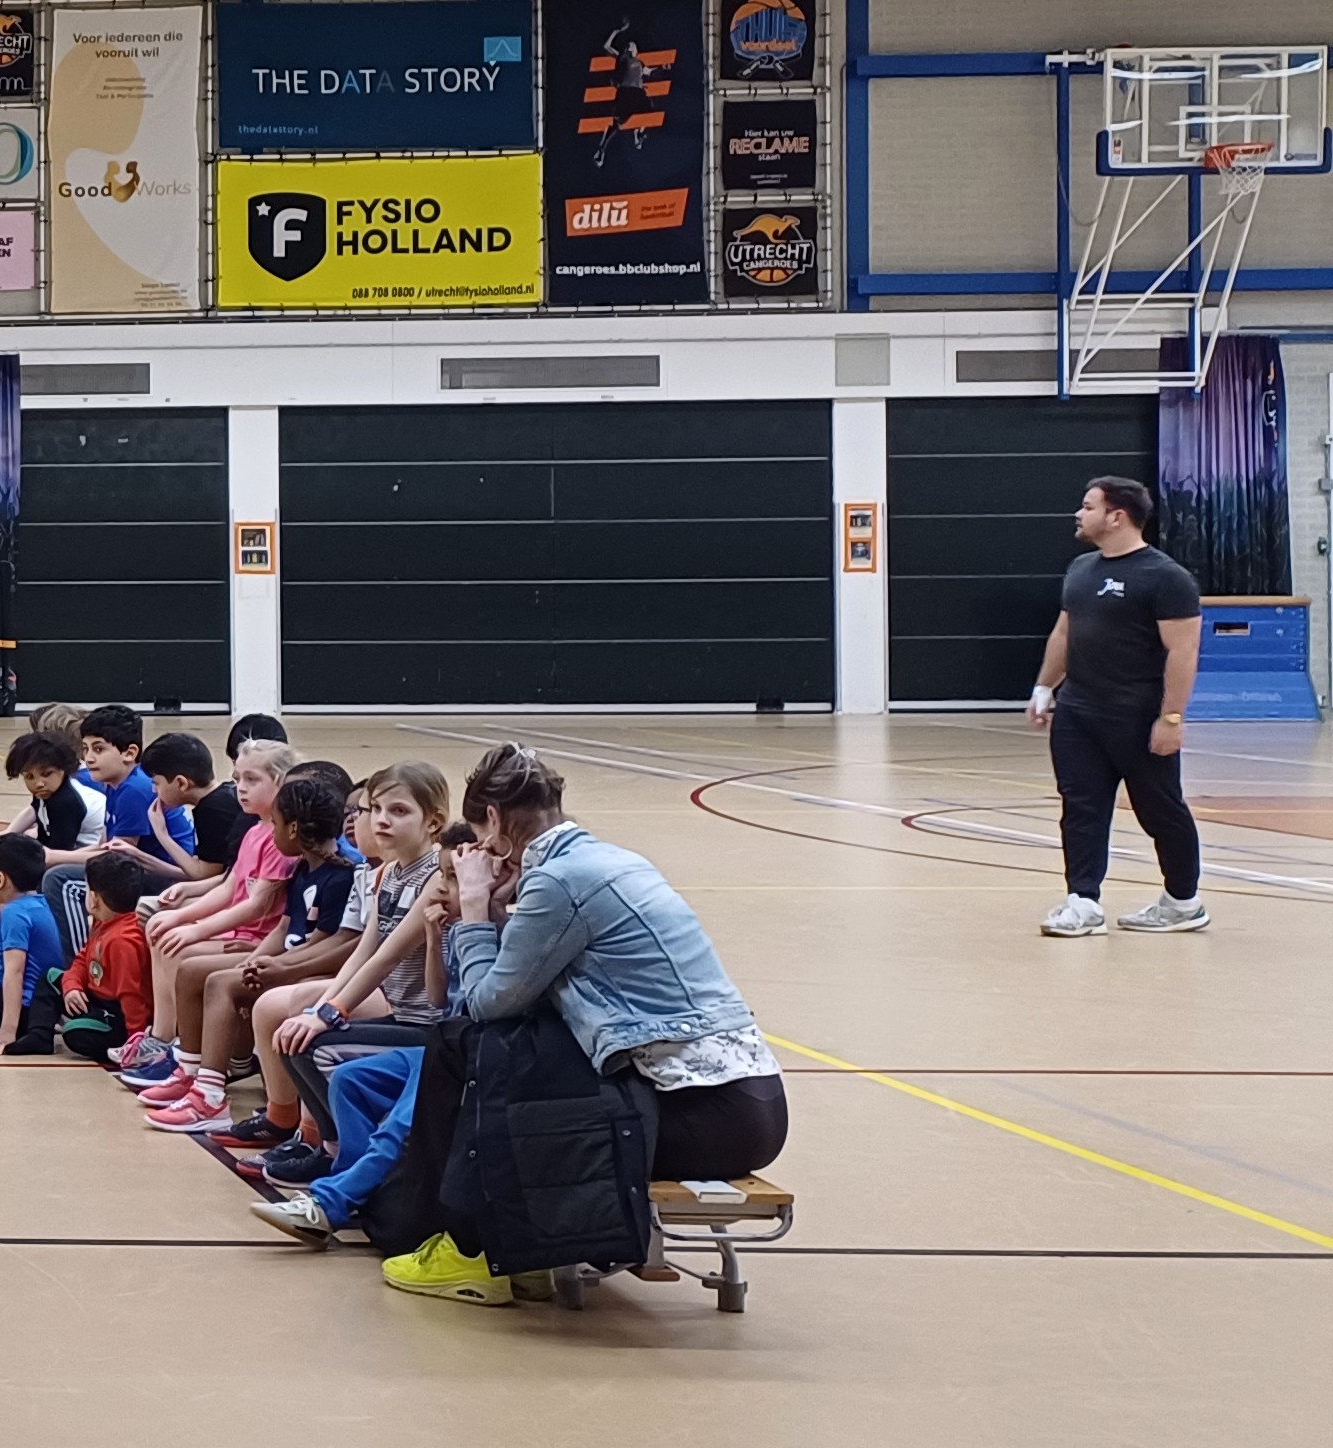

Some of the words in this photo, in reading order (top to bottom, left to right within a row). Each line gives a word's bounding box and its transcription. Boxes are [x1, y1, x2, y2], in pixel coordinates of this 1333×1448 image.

[73, 33, 102, 44] Voor
[105, 32, 161, 43] iedereen
[163, 31, 183, 42] die
[95, 48, 139, 58] vooruit
[141, 47, 160, 58] wil
[252, 68, 309, 94] THE
[320, 69, 395, 95] DATA
[404, 61, 500, 93] STORY
[729, 137, 809, 155] RECLAME
[58, 182, 112, 198] Good
[133, 179, 192, 196] Works
[336, 198, 441, 226] FYSIO
[336, 226, 512, 256] HOLLAND
[730, 243, 811, 262] UTRECHT
[555, 261, 701, 276] cangeroes.bbclubshop.nl
[743, 260, 798, 270] CANGEROES
[372, 287, 389, 297] 708
[391, 286, 415, 298] 0800
[425, 282, 535, 298] utrecht@fysioholland.nl
